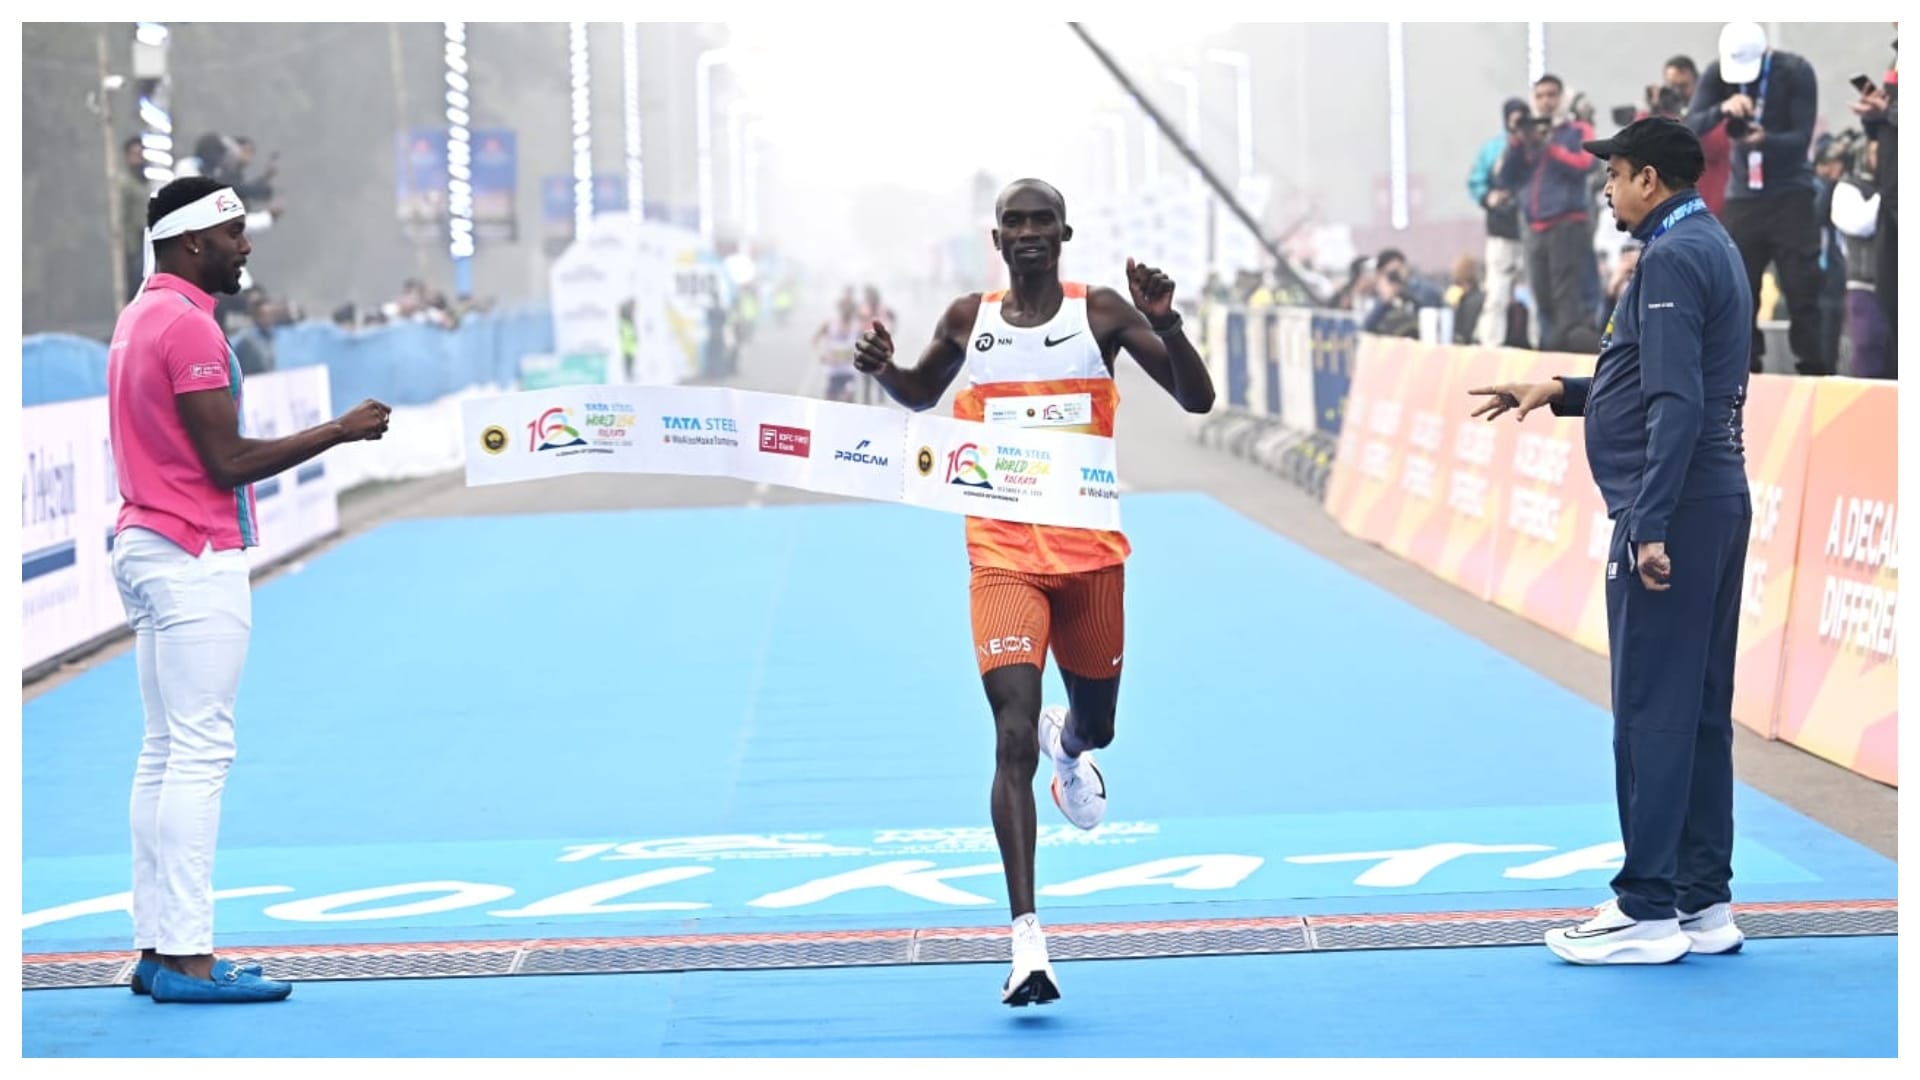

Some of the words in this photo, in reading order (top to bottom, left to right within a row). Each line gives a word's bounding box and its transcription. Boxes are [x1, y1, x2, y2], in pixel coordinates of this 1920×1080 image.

[998, 338, 1013, 346] NN
[662, 416, 701, 430] TATA
[705, 418, 738, 433] STEEL
[835, 450, 888, 466] PROCAM
[997, 446, 1021, 457] TATA
[1025, 450, 1051, 460] STEEL
[995, 457, 1028, 473] WORLD
[1080, 468, 1115, 484] TATA
[1825, 495, 1844, 556] A
